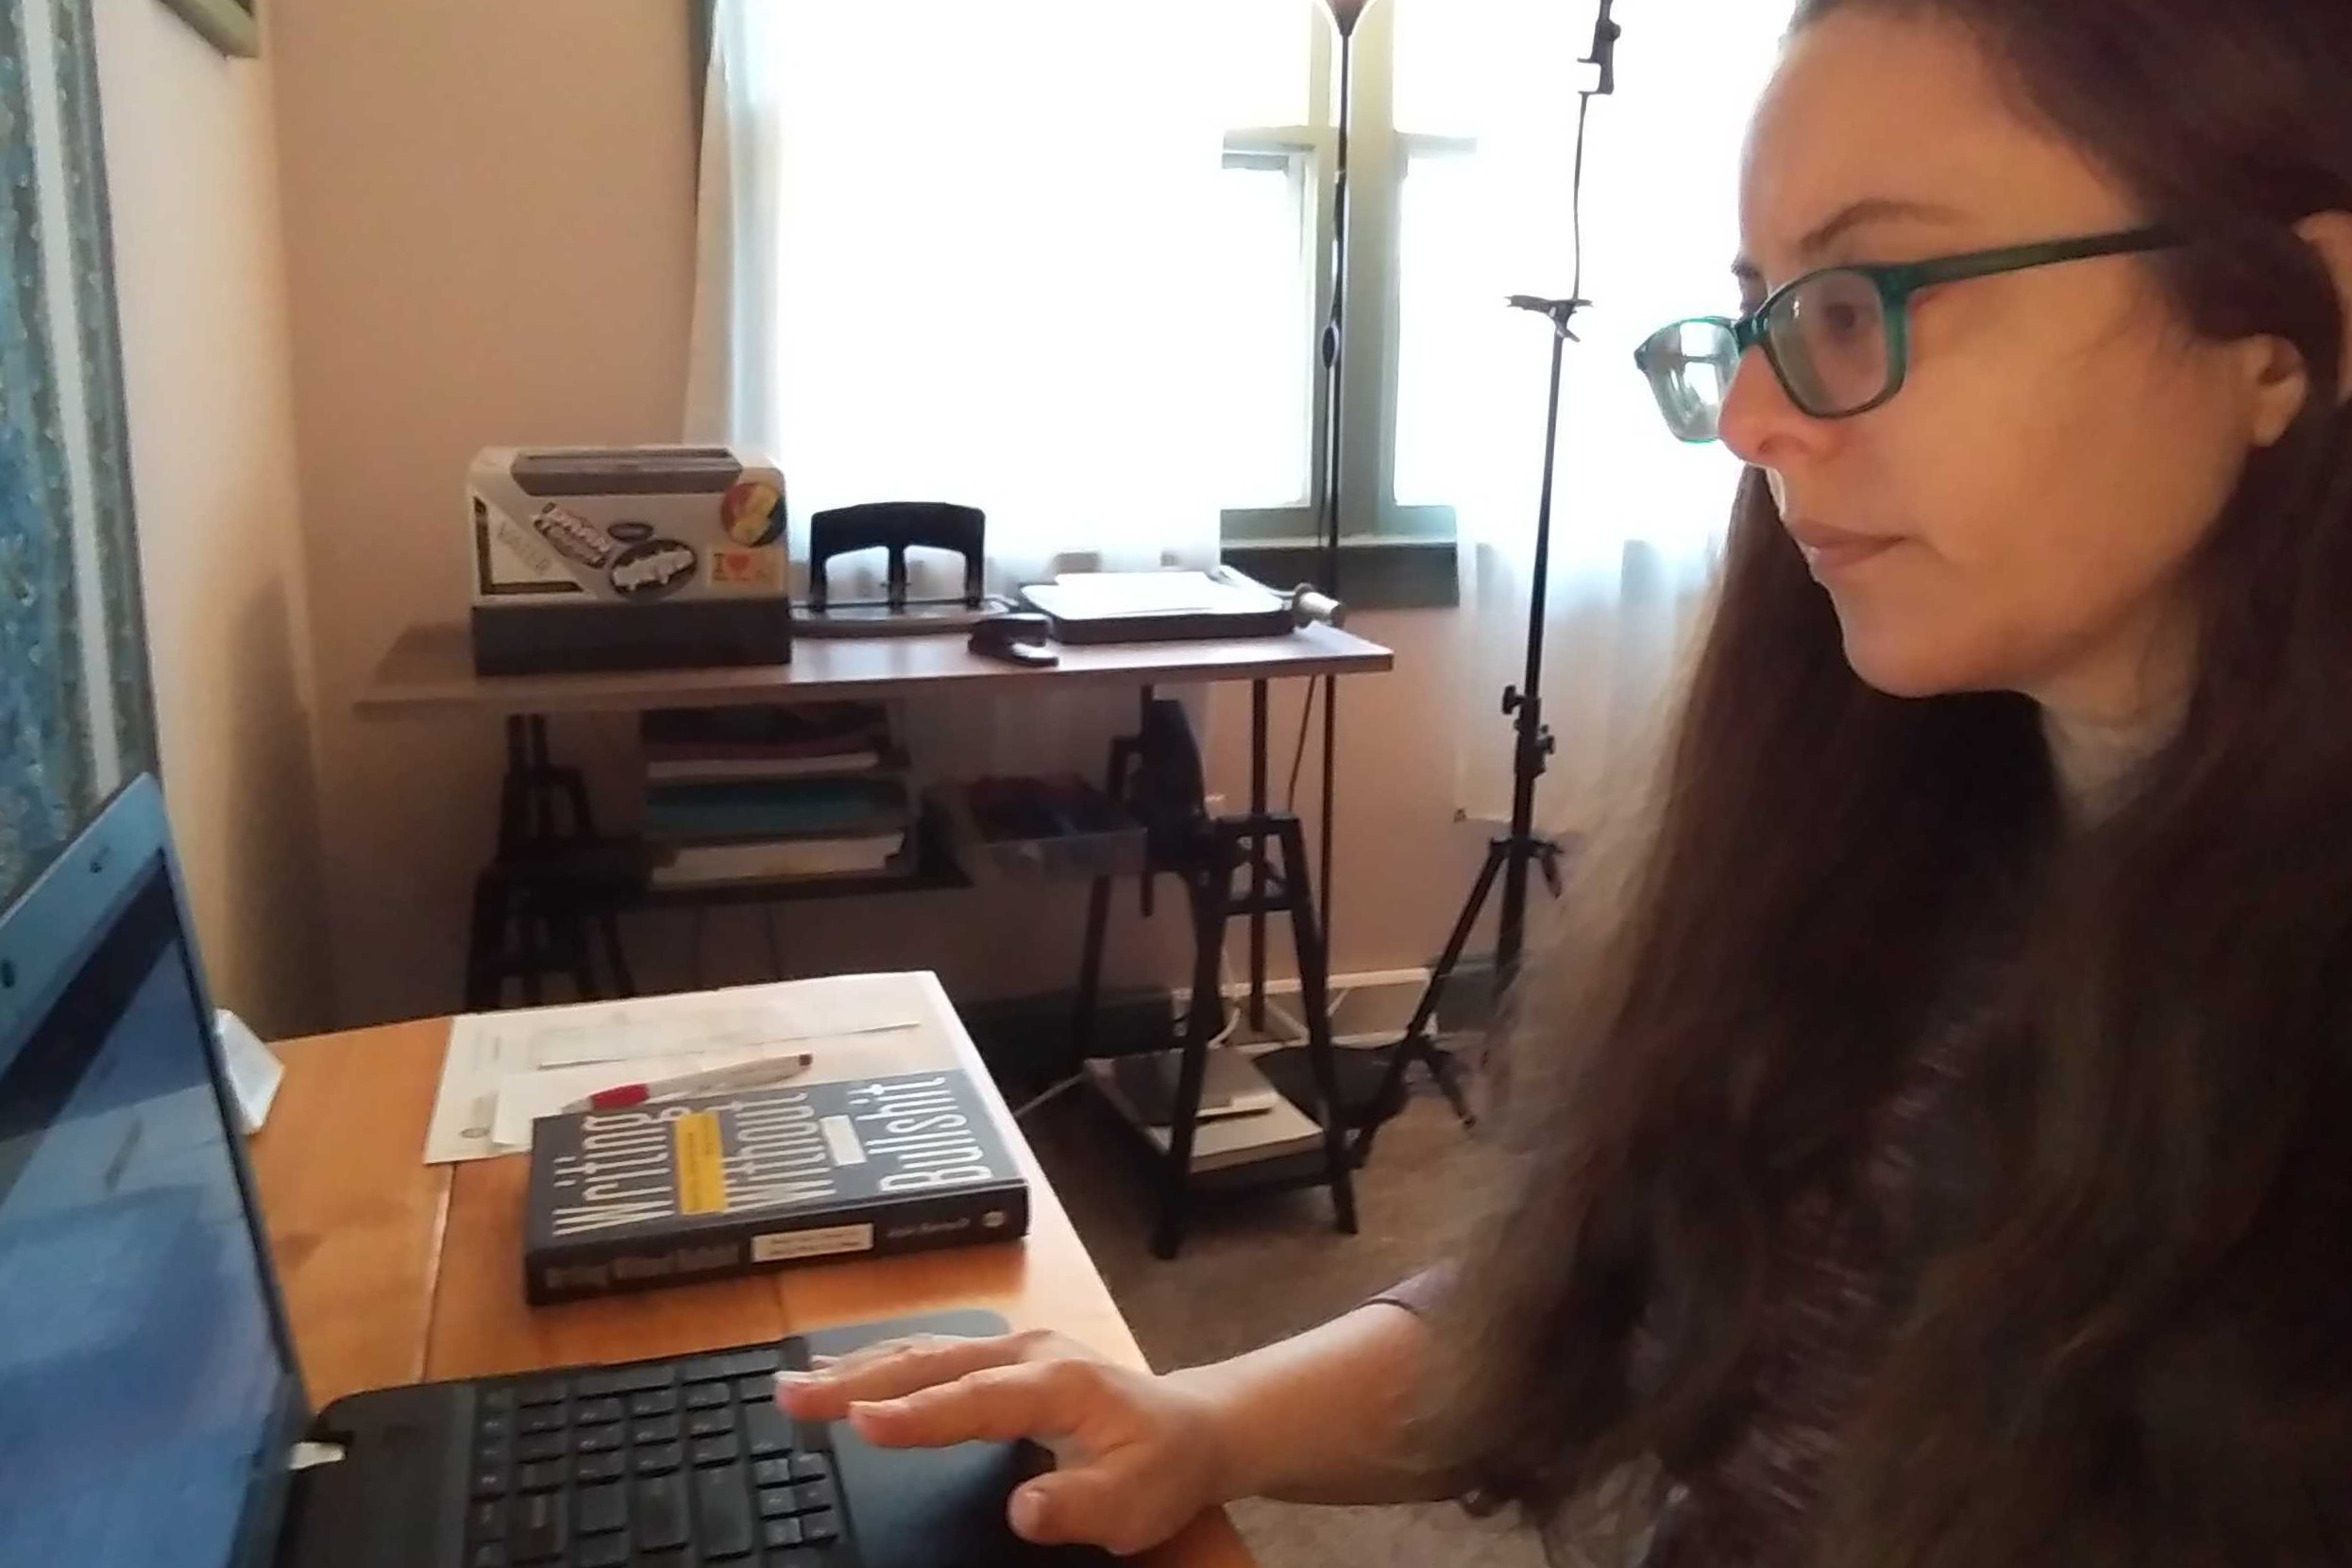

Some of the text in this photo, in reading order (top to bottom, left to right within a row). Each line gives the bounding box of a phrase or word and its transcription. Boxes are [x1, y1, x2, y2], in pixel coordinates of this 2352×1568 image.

[552, 1107, 691, 1237] Writing
[704, 1092, 838, 1213] Without
[847, 1076, 993, 1192] Bullshit
